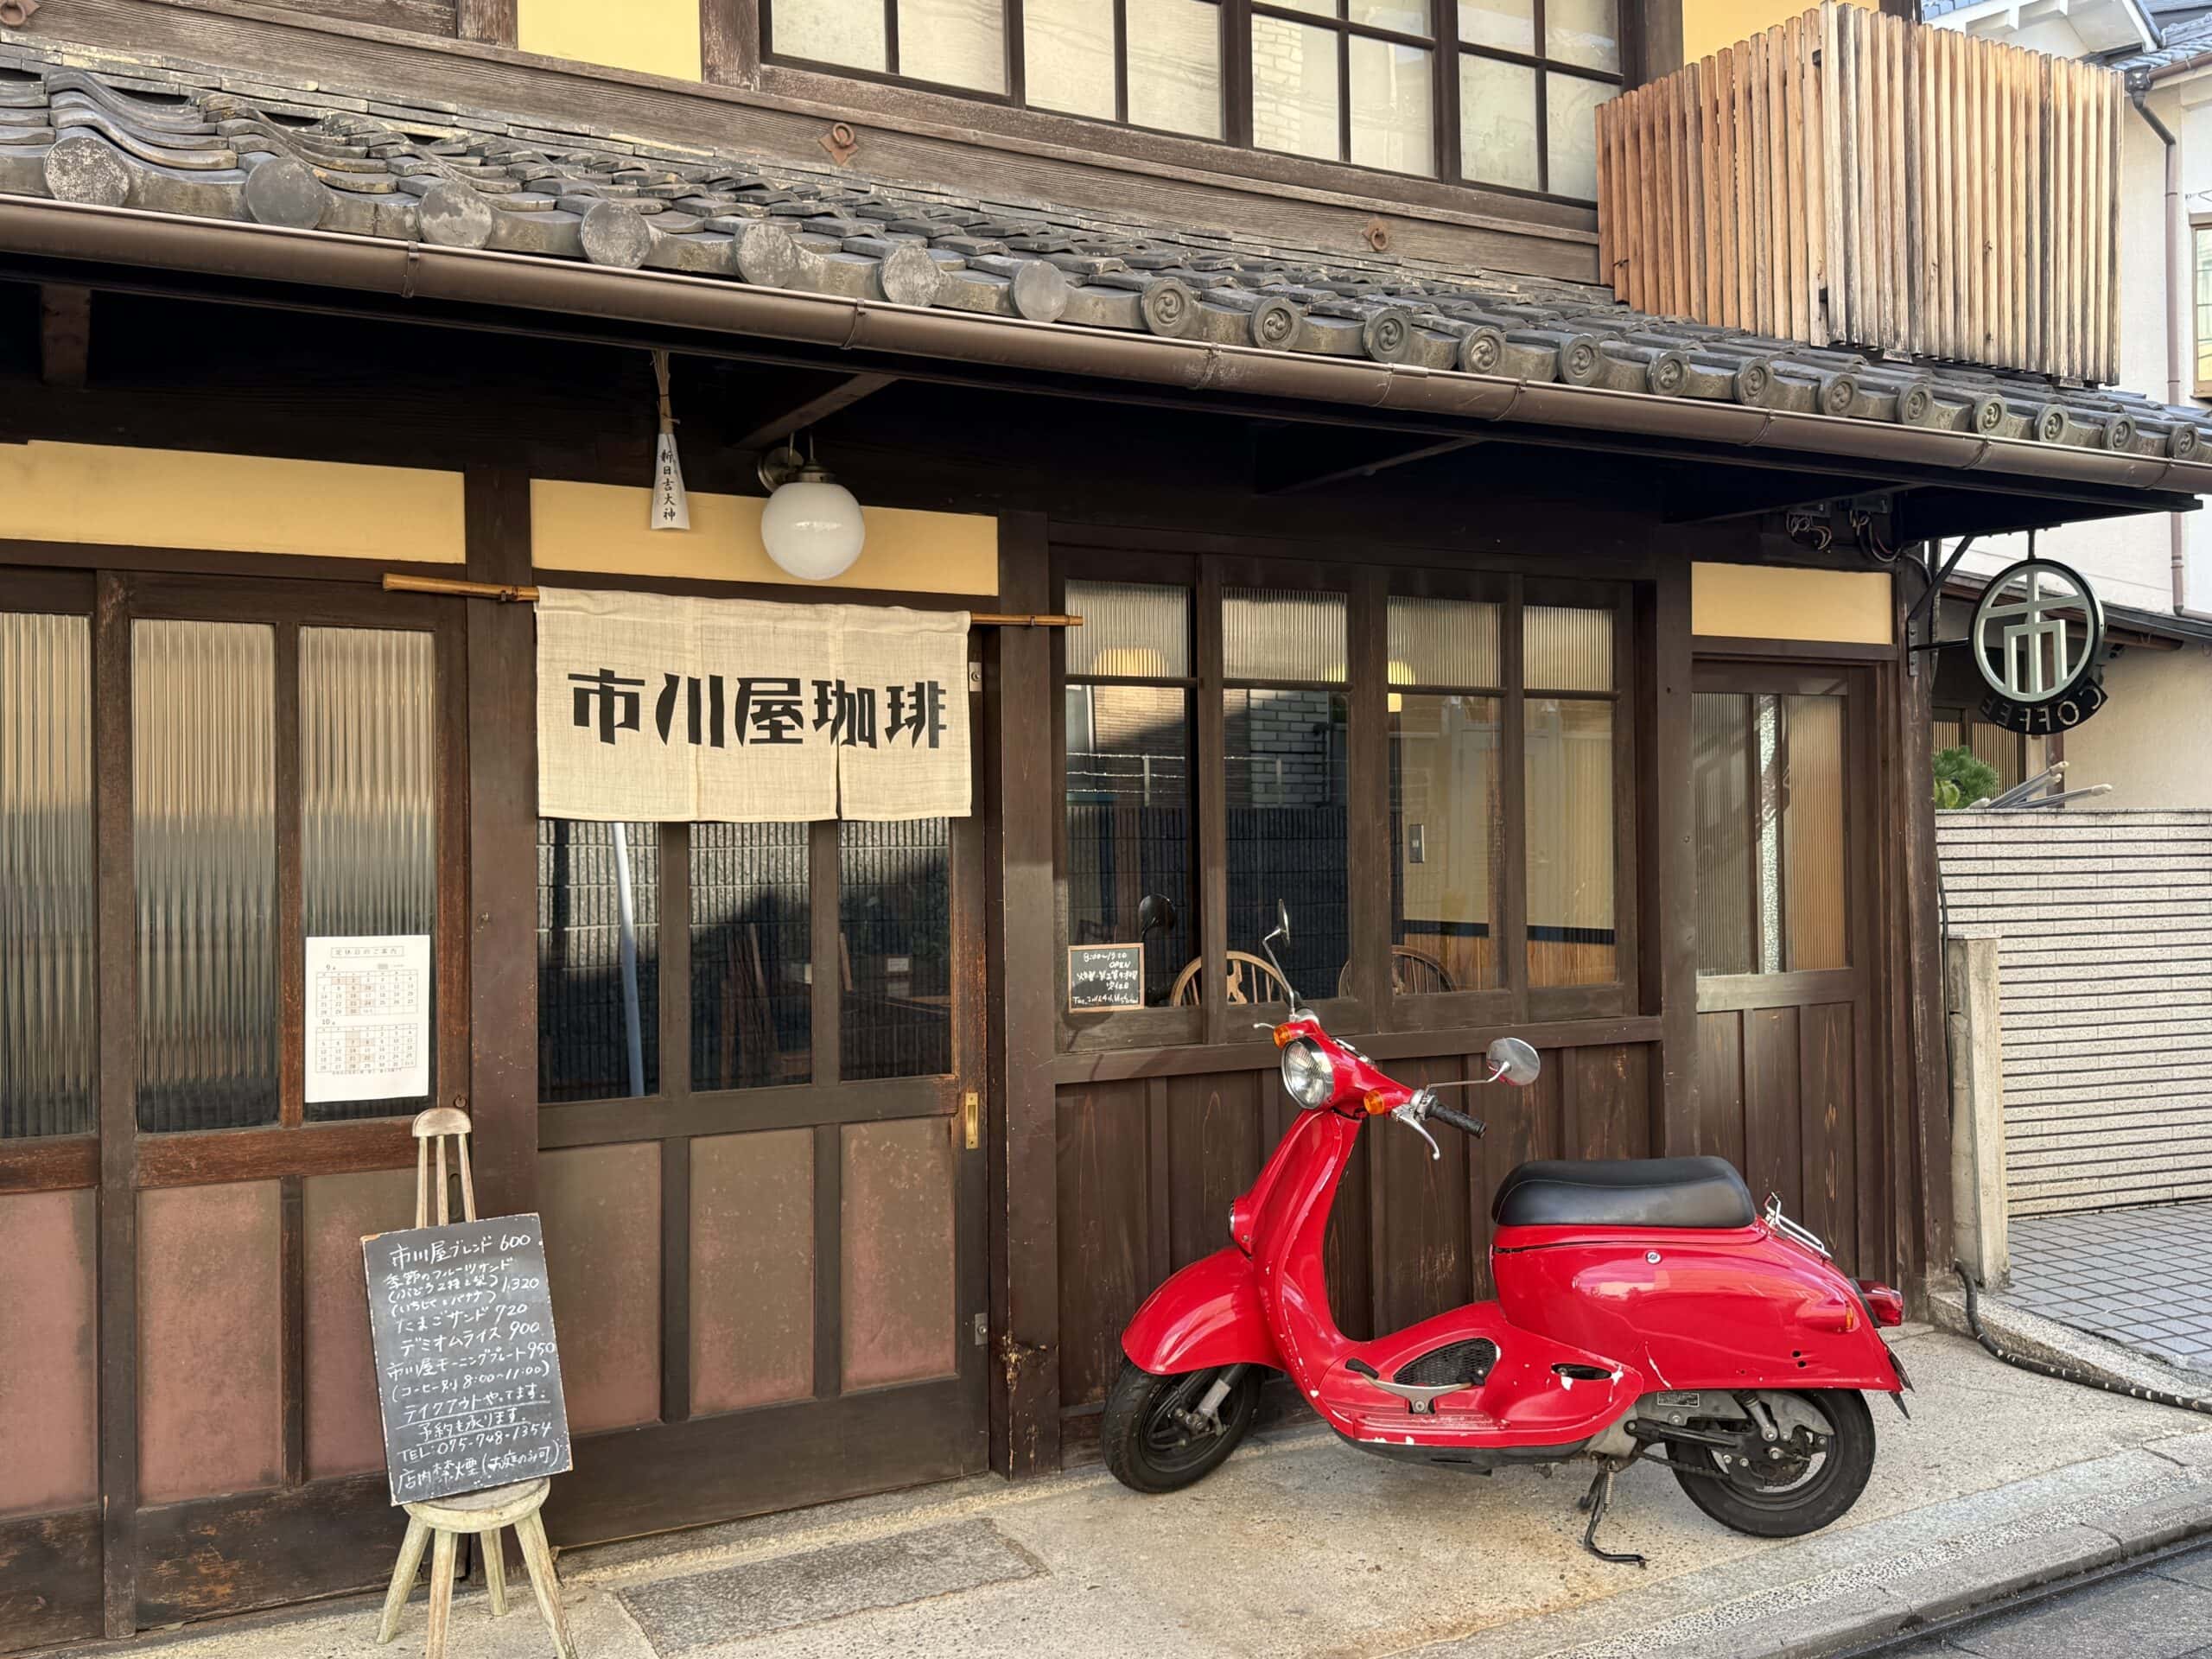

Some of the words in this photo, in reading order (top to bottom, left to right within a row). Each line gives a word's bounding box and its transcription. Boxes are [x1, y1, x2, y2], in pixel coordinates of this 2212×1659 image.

[568, 668, 947, 748] 市川屋珈琲
[389, 1236, 493, 1270] 市川屋ブレンド
[499, 1234, 531, 1251] 600
[396, 1306, 489, 1334] たまごサンド
[495, 1304, 528, 1324] 720
[401, 1327, 501, 1357] デミオムライス
[510, 1321, 539, 1340] 900
[386, 1346, 526, 1381] 市川屋モーニングプレート
[527, 1341, 555, 1359] 950
